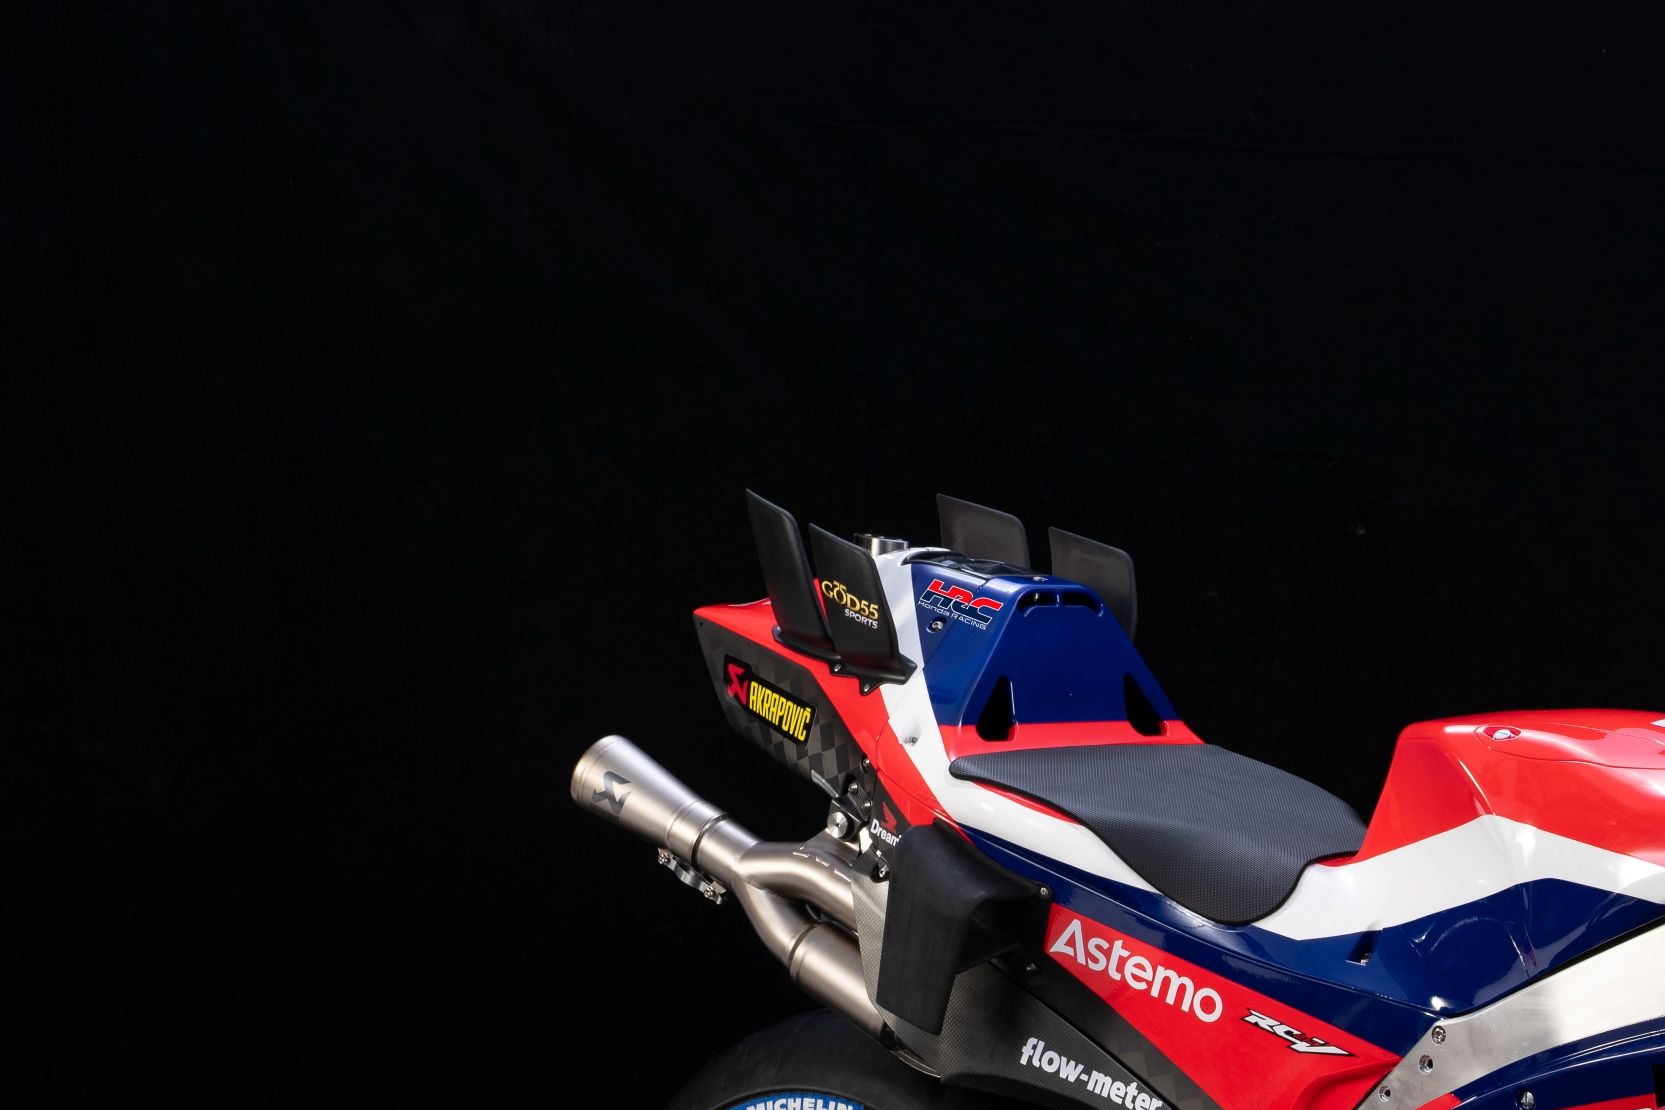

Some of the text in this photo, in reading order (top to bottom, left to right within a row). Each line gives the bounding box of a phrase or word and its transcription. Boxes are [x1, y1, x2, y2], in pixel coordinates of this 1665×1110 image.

[919, 578, 1004, 625] HRC
[844, 608, 879, 630] SPORTS
[950, 612, 987, 630] RACING
[1049, 918, 1224, 1023] Astemo
